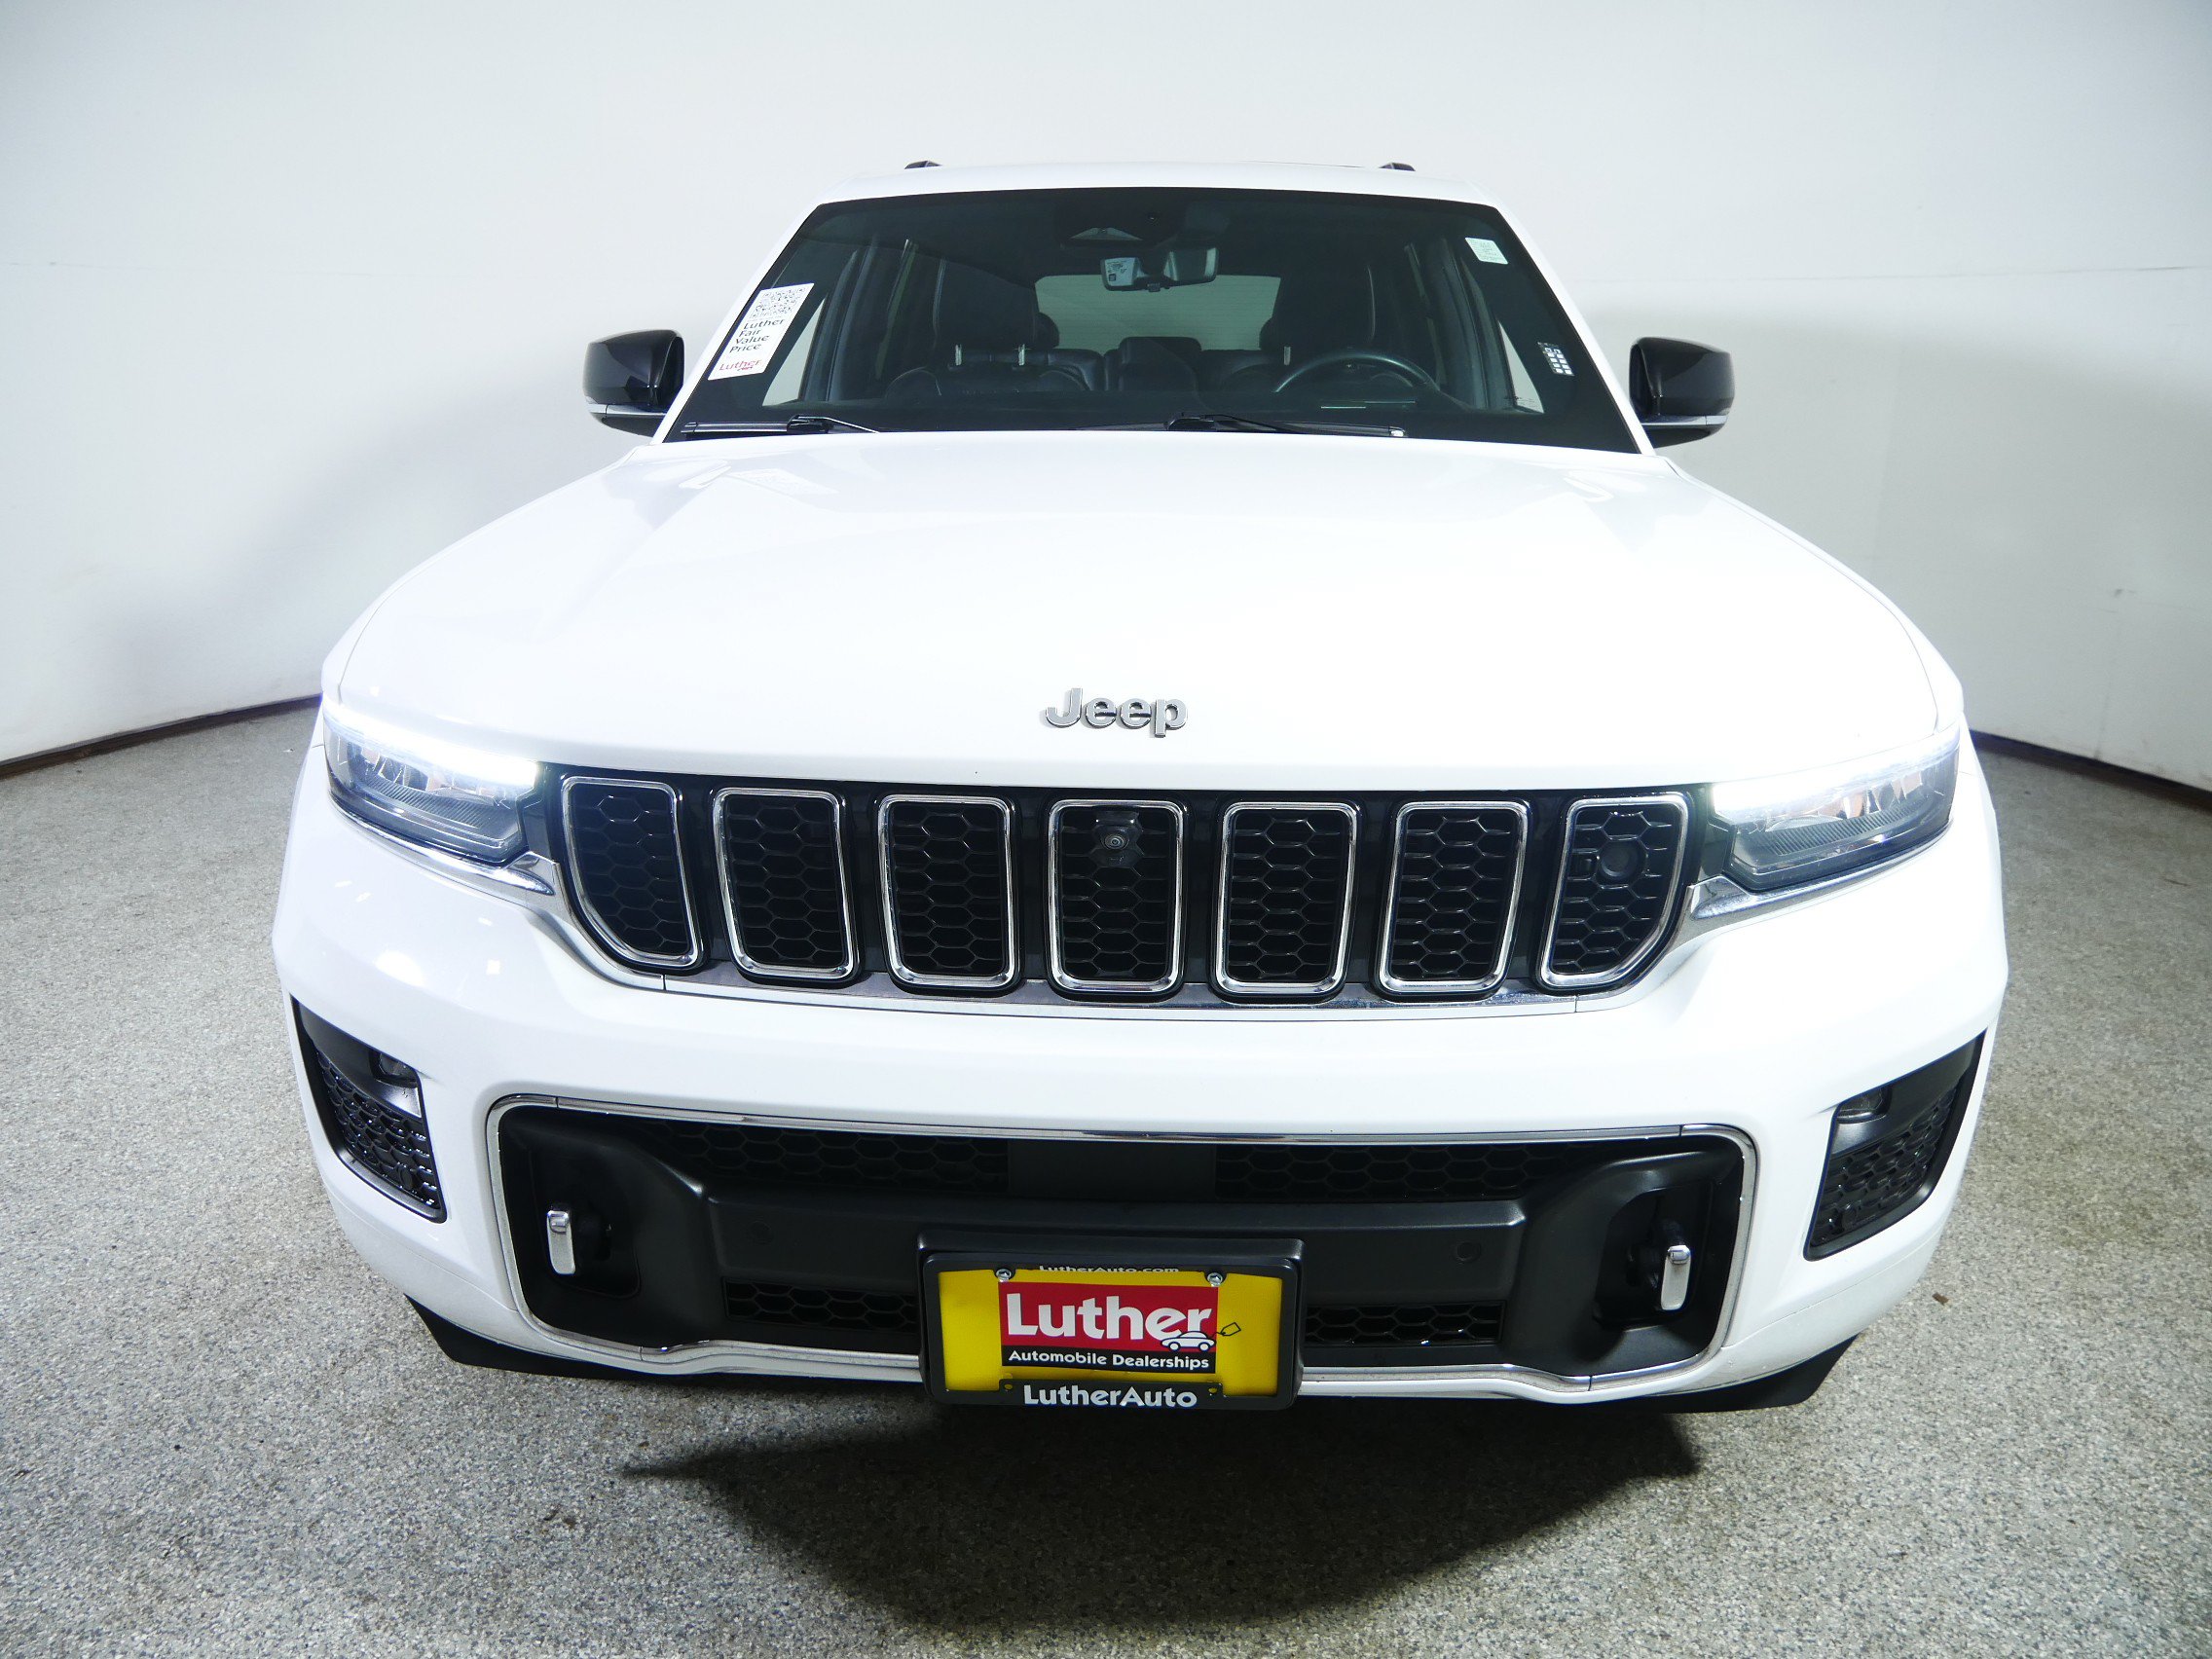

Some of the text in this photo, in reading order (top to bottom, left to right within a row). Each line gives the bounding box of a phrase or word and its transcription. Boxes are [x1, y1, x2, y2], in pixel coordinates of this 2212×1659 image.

[1045, 687, 1188, 738] Jeep
[1006, 1293, 1212, 1341] Luther
[1008, 1349, 1210, 1371] Automobile Dealerships
[1023, 1384, 1198, 1409] LutherAuto
